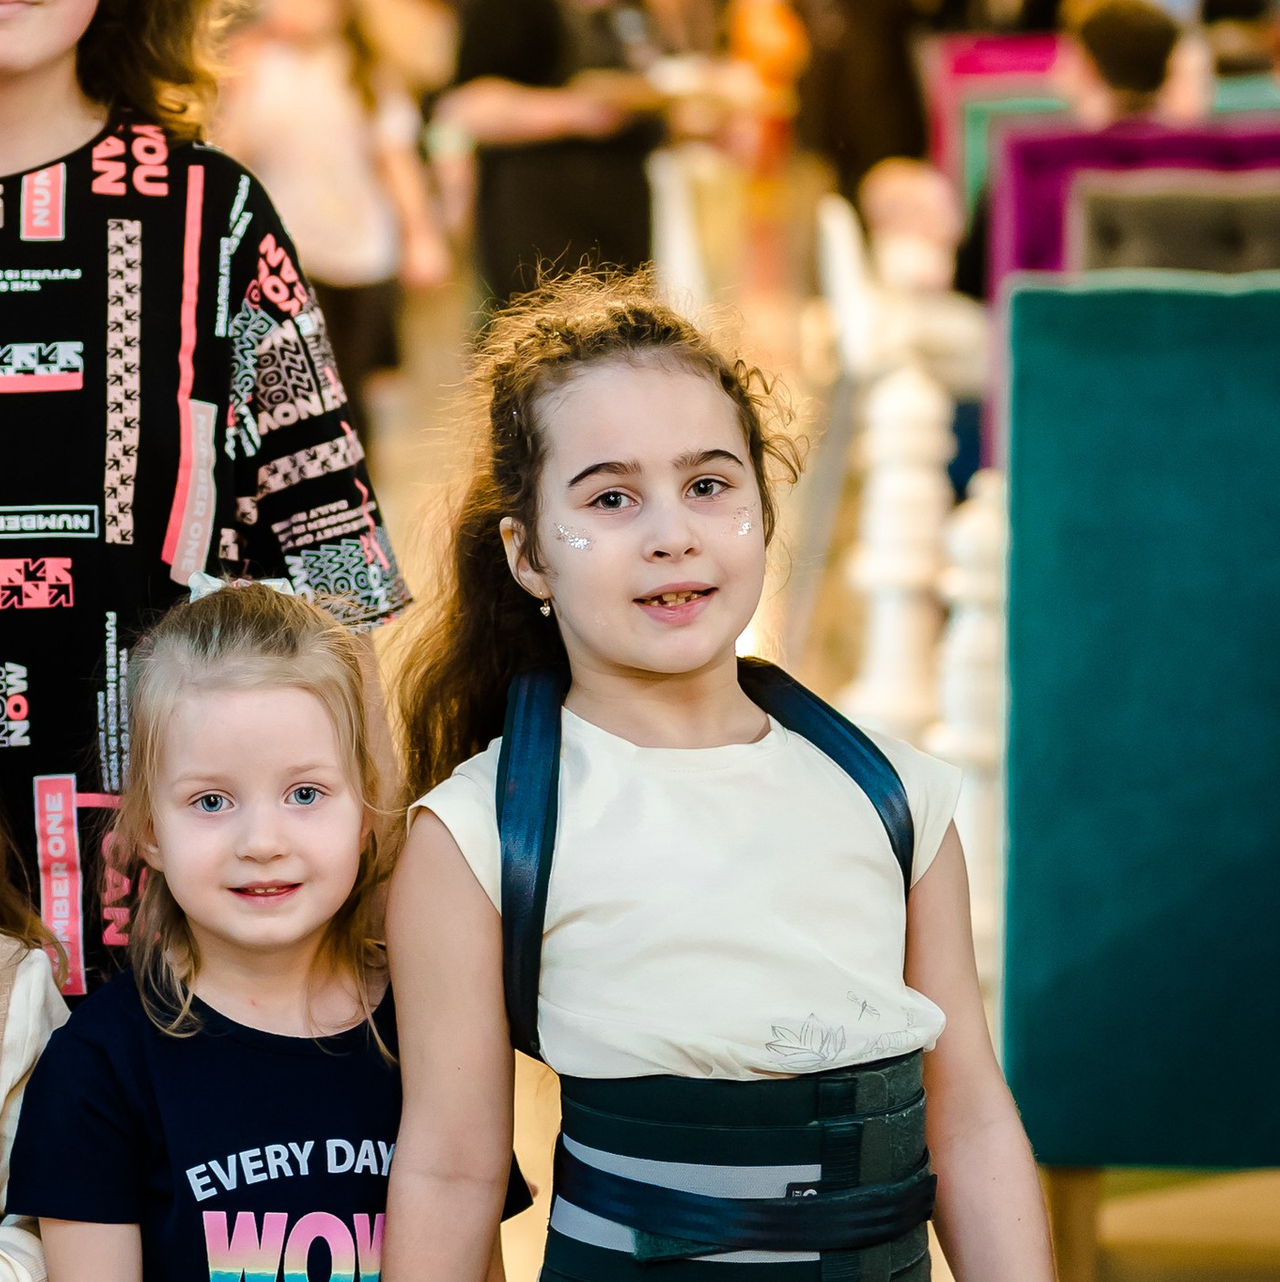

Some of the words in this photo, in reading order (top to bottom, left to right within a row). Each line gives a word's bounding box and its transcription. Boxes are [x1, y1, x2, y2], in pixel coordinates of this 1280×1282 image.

[91, 125, 126, 197] AN
[45, 792, 67, 857] ONE
[185, 1140, 315, 1202] EVERY
[325, 1138, 396, 1177] DAY
